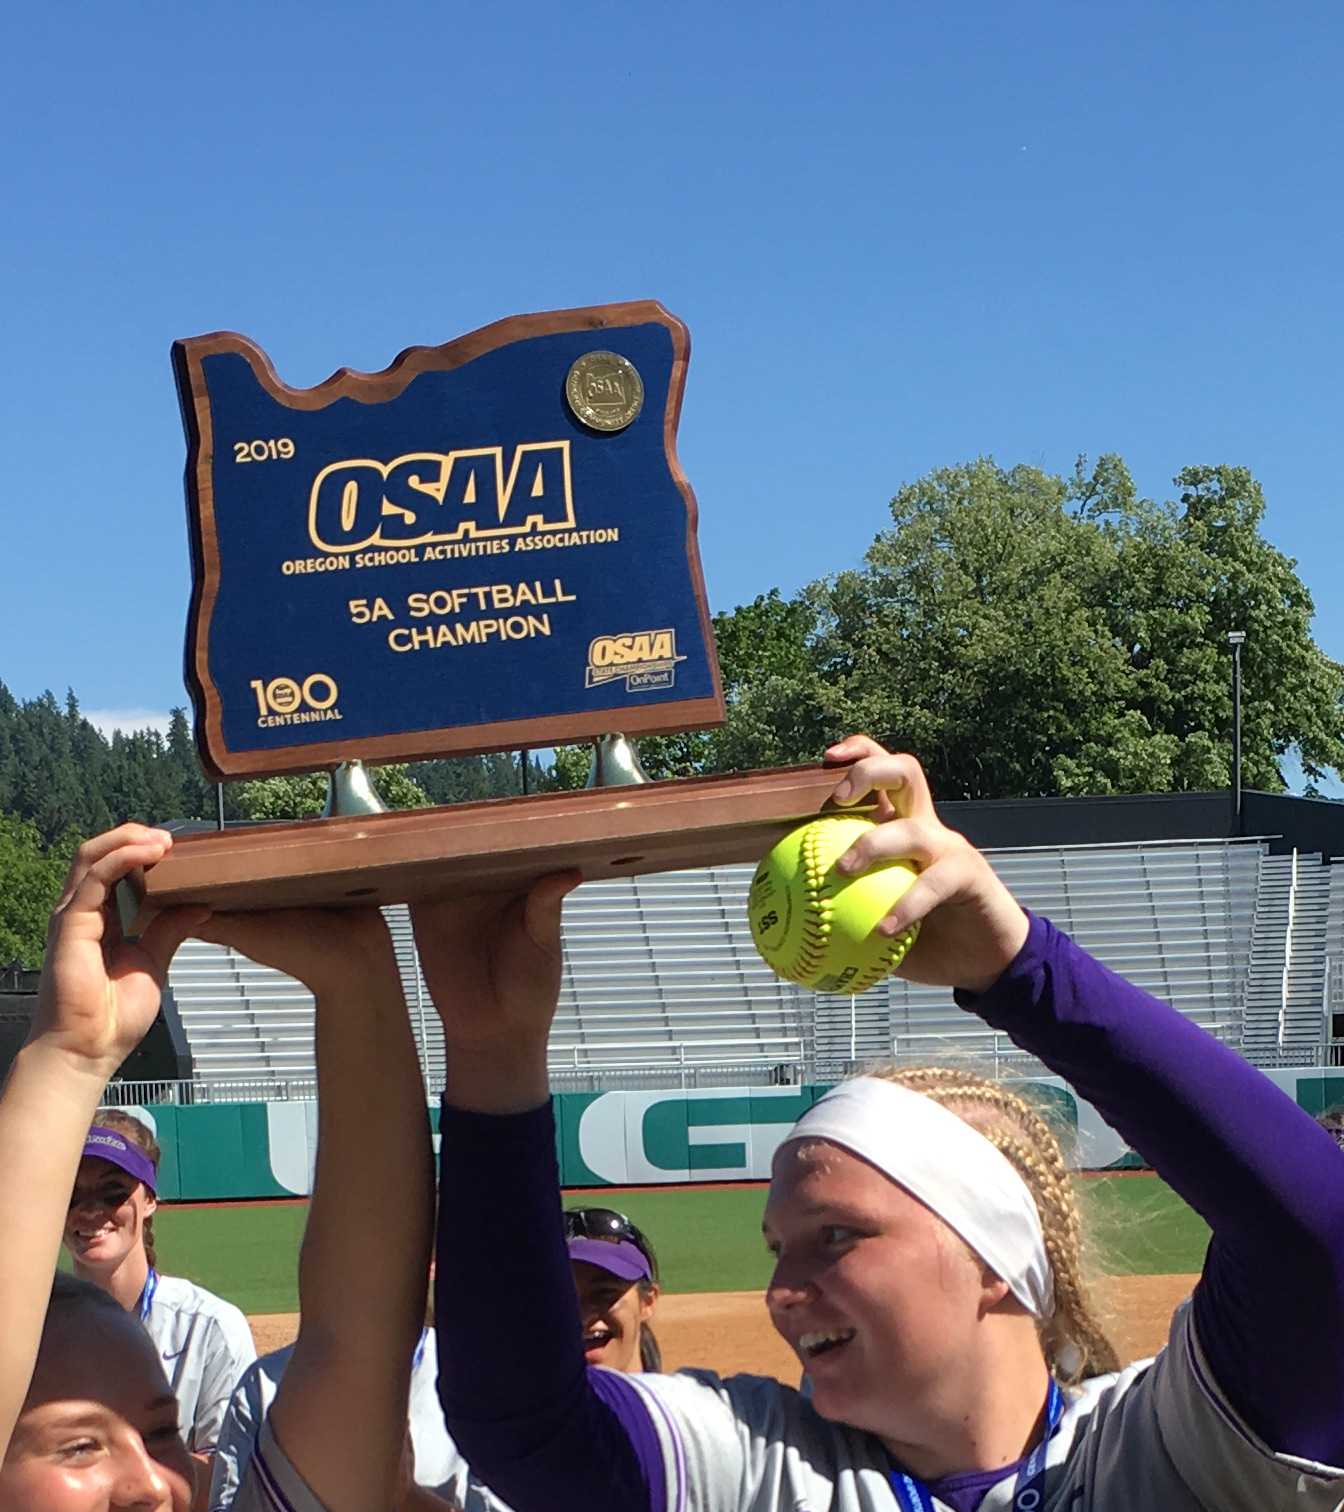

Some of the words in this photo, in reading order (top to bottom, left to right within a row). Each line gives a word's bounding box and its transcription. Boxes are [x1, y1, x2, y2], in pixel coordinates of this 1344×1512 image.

[233, 437, 295, 463] 2019
[308, 440, 576, 553] OSAA
[281, 555, 350, 576] OREGON
[355, 547, 419, 568] SCHOOL
[423, 539, 510, 562] ACTIVITIES
[514, 527, 620, 552] ASSOCIATION
[348, 597, 396, 624] 5A
[407, 579, 577, 618] SOFTBALL
[388, 613, 552, 652] CHAMPION
[592, 632, 672, 667] OSAA
[250, 673, 338, 716] 100
[257, 708, 344, 728] CENTENNIAL
